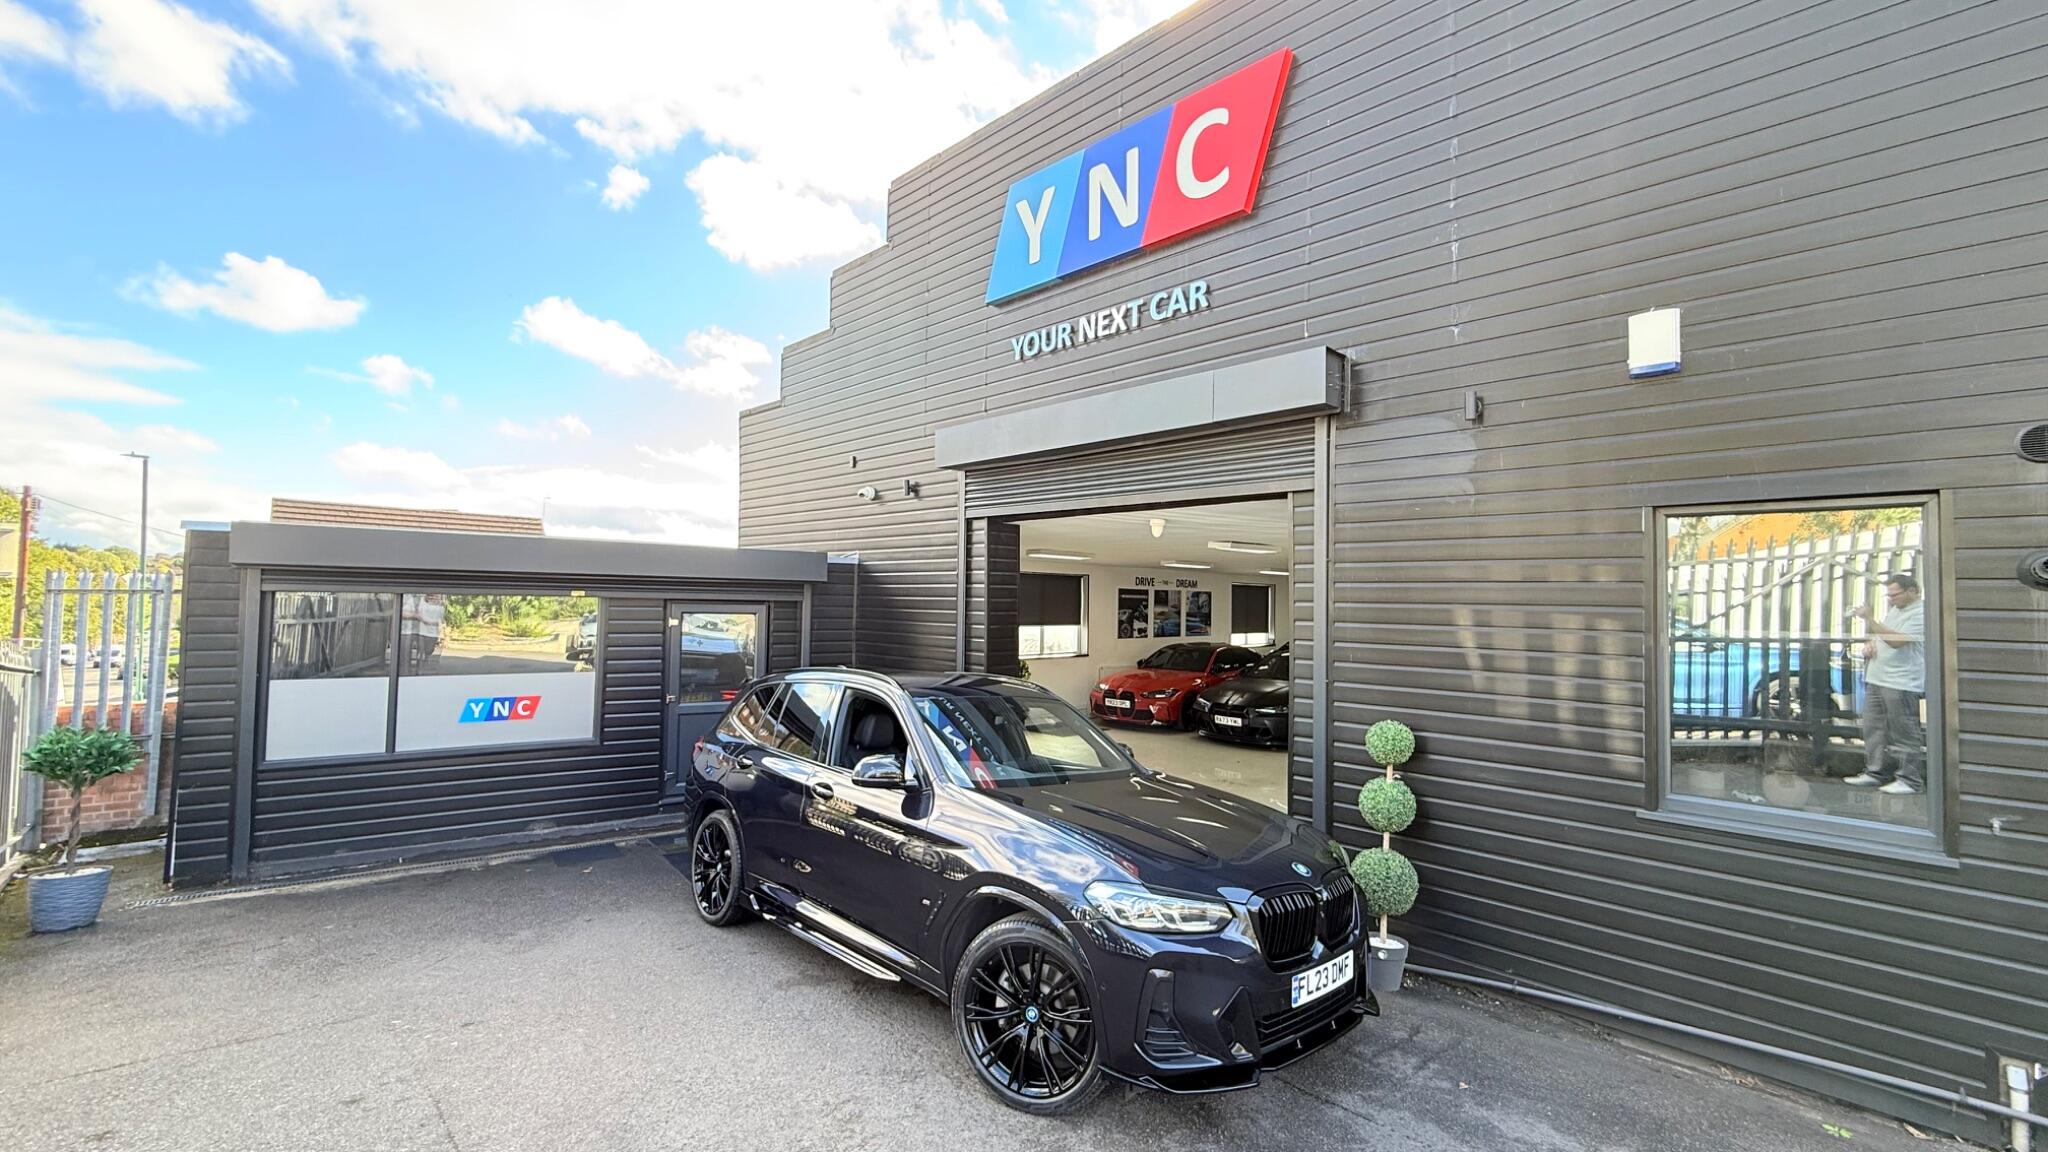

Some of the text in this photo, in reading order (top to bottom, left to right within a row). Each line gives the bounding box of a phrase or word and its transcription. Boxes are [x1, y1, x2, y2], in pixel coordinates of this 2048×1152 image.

[1015, 107, 1230, 264] YNC
[1010, 280, 1210, 361] YOUR NEXT CAR
[1135, 576, 1155, 587] DRIVE
[1176, 579, 1198, 588] DREAM
[469, 700, 531, 718] YNC
[1298, 955, 1350, 999] FL23 DMF
